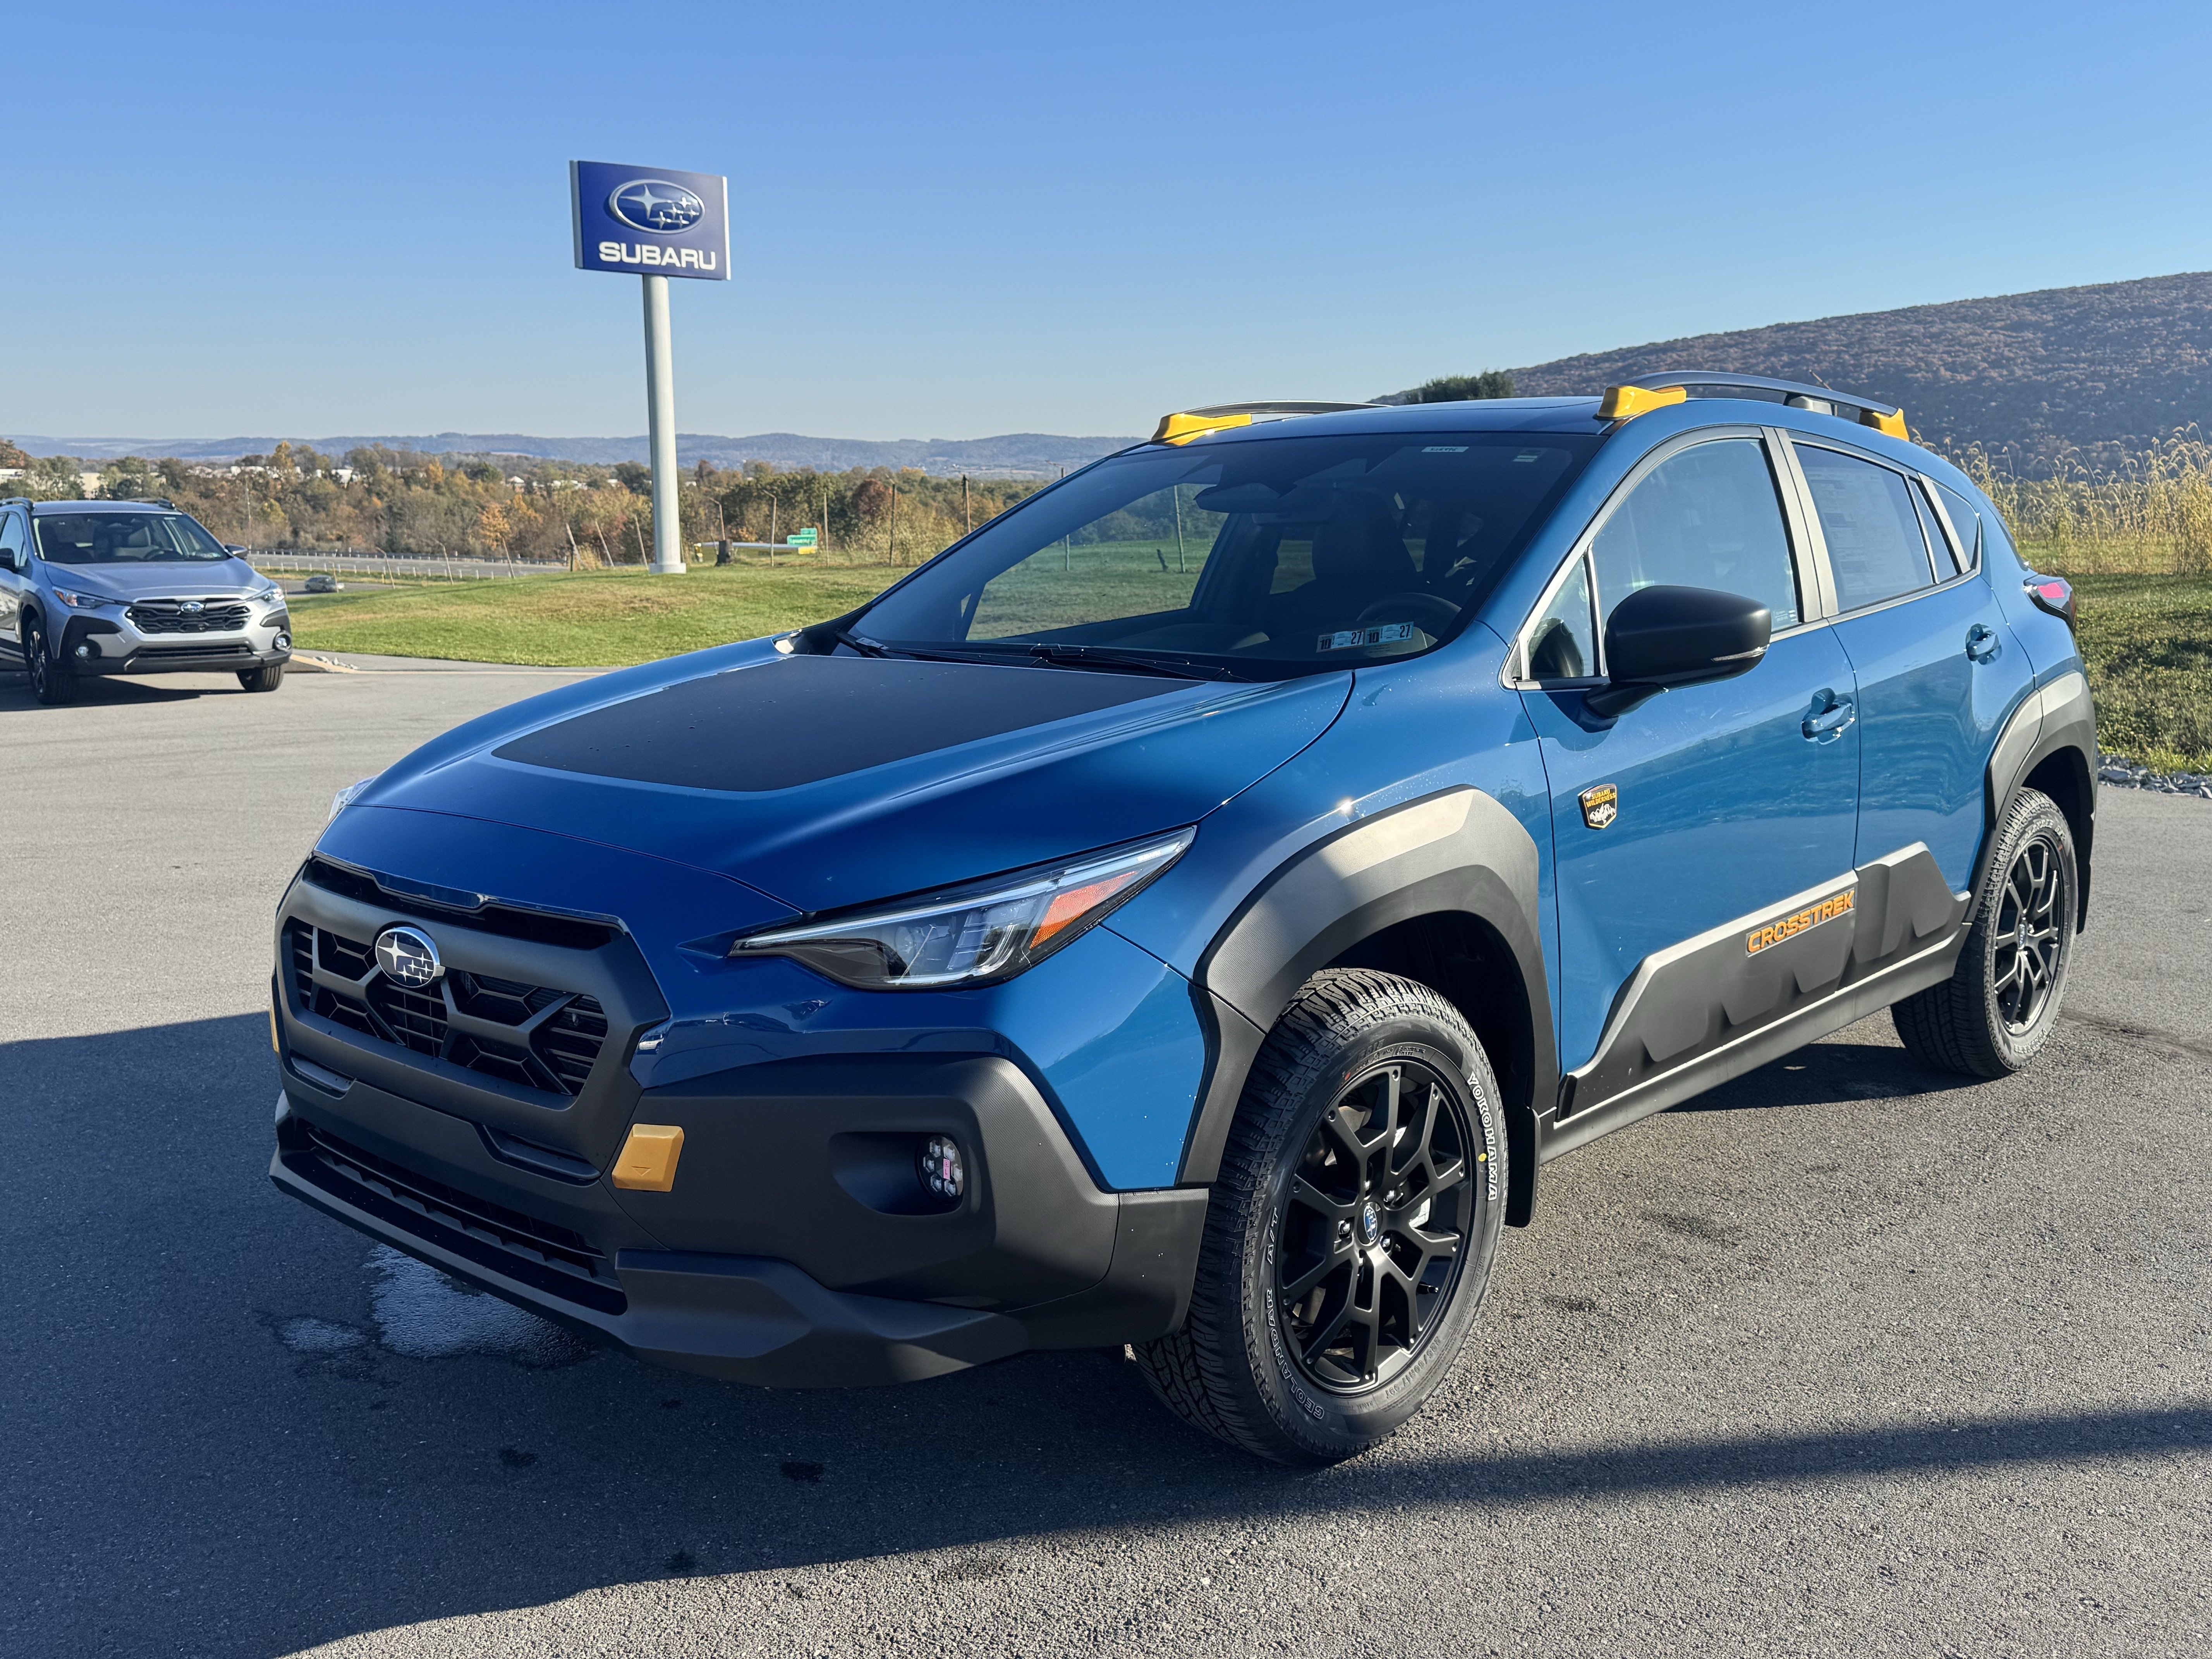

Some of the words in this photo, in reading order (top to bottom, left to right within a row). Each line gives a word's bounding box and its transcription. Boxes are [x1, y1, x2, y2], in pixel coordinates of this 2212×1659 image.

[599, 241, 716, 270] SUBARU
[1320, 638, 1331, 650] 10
[1351, 631, 1362, 644] 27
[1367, 632, 1379, 644] 10
[1400, 624, 1410, 638] 27
[1586, 792, 1616, 808] WILDERNESS
[1591, 788, 1611, 800] SUBARU
[1748, 890, 1855, 953] CROSSTREK
[1467, 1071, 1498, 1201] YOKOHAMA
[1267, 1207, 1278, 1264] A/T
[1266, 1288, 1325, 1419] GEOLANDAR
